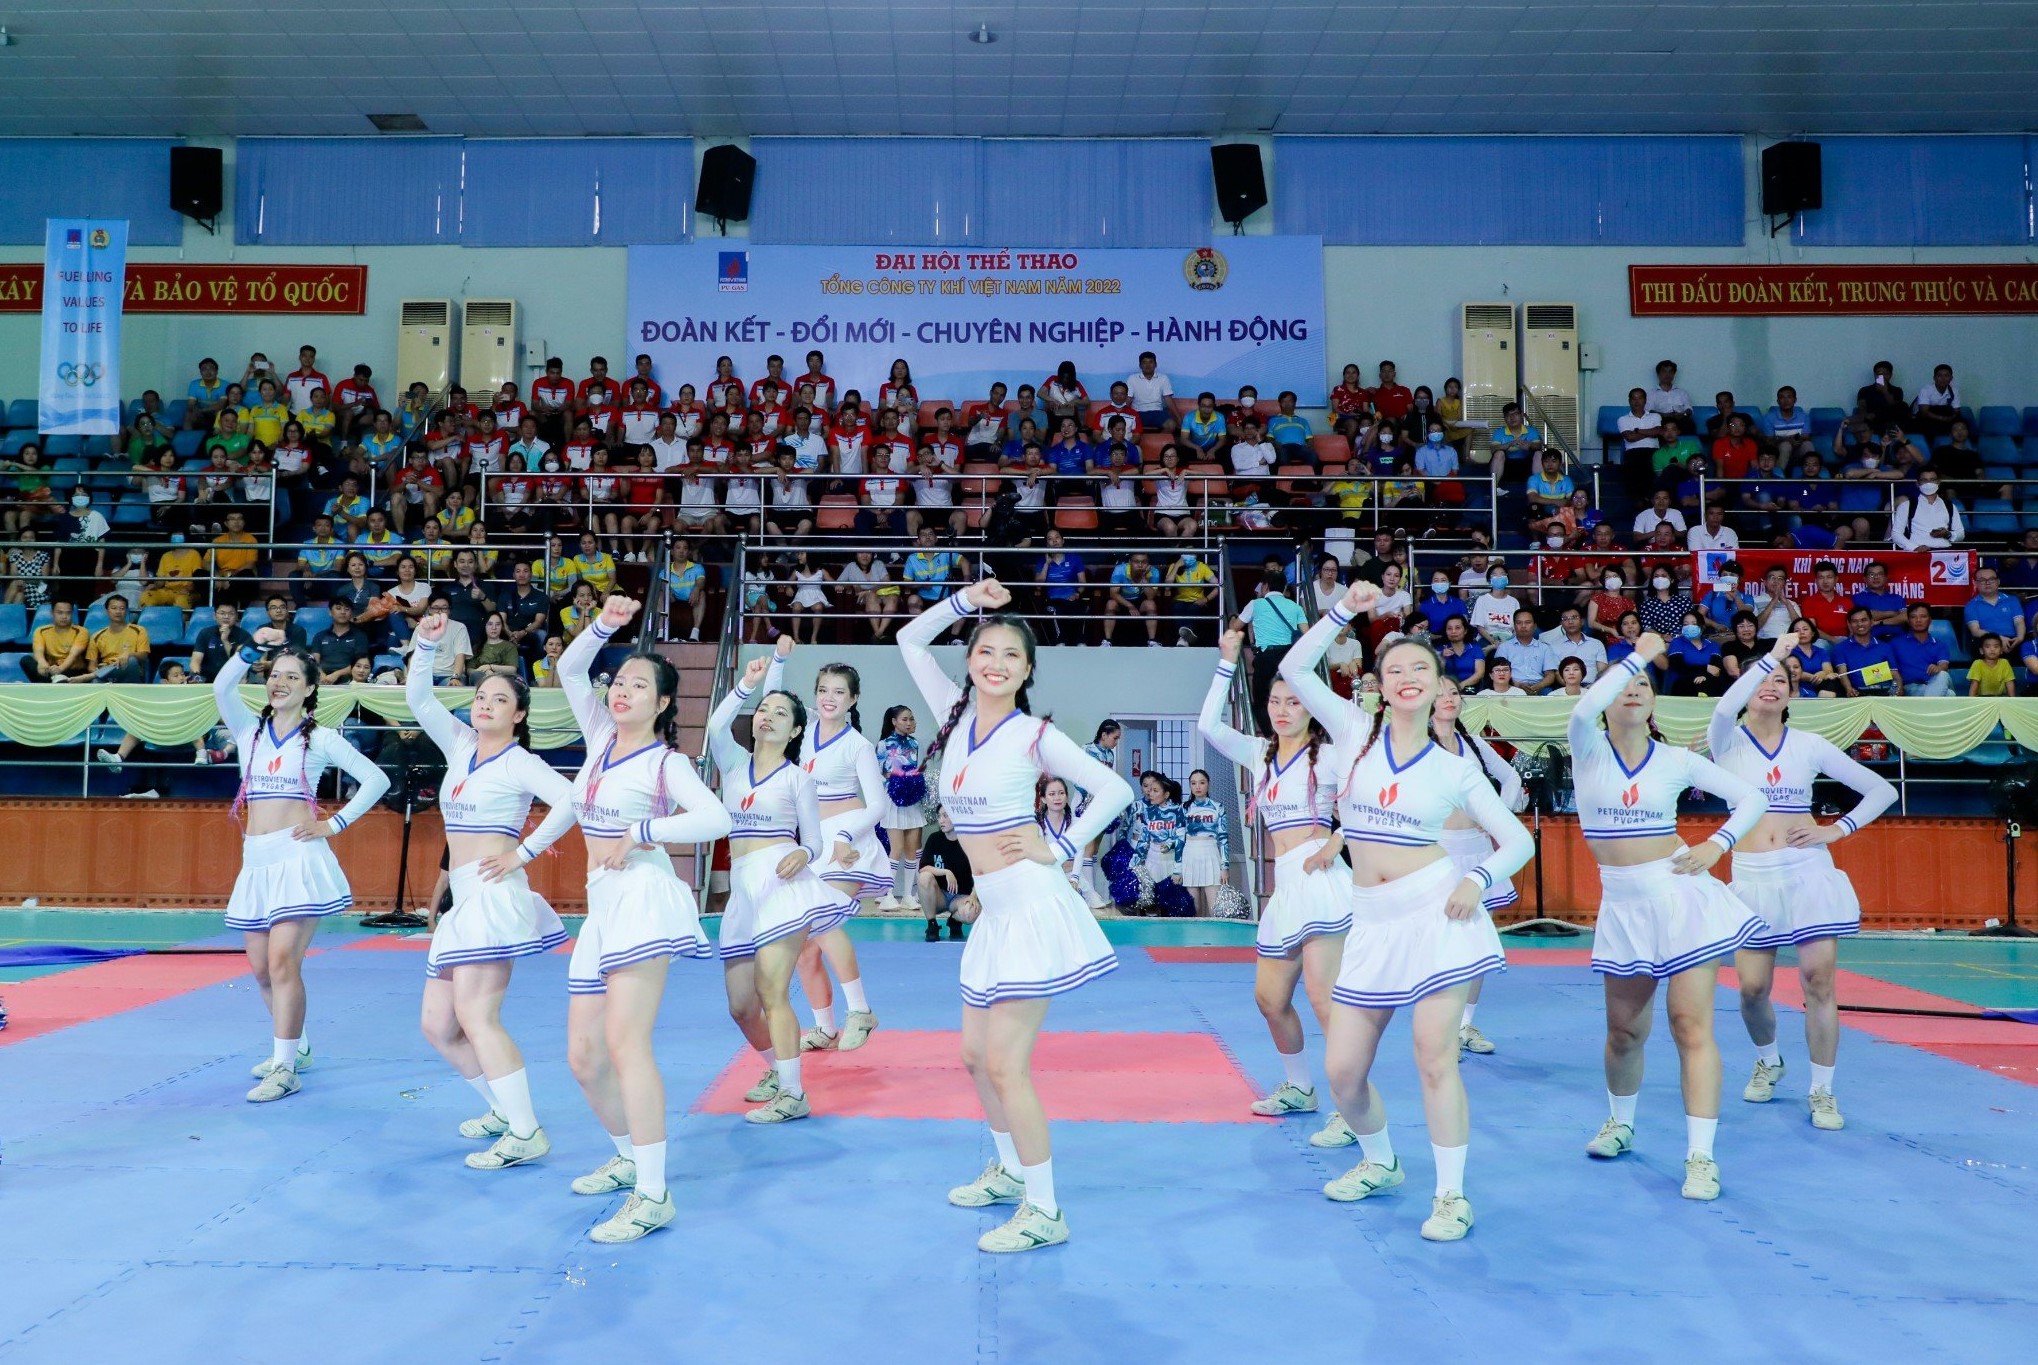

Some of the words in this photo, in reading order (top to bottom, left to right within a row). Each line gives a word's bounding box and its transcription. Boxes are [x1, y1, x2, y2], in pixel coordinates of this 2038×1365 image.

[875, 254, 915, 273] ĐẠI
[921, 250, 961, 274] HỘI
[966, 246, 1011, 270] THỂ
[1017, 253, 1078, 270] THAO
[57, 271, 112, 283] FUELLING
[820, 273, 863, 294] TỔNG
[867, 277, 914, 294] CÔNG
[918, 280, 935, 294] TY
[940, 276, 965, 294] KHÍ
[969, 277, 1001, 297] VIỆT
[1005, 279, 1041, 294] NAM
[1045, 277, 1082, 294] NĂM
[1085, 279, 1121, 294] 2022
[153, 272, 201, 301] BẢO
[208, 276, 238, 306] VỆ
[246, 272, 277, 302] TỔ
[283, 272, 349, 306] QUỐC
[1641, 282, 1676, 303] THI
[1681, 272, 1722, 303] ĐẤU
[1728, 275, 1783, 303] ĐOÀN
[1788, 272, 1834, 307] KẾT,
[1838, 281, 1905, 302] TRUNG
[1911, 276, 1966, 307] THỰC
[1971, 275, 1998, 302] VÀ
[62, 296, 105, 308] VALUES
[63, 322, 78, 333] TO
[81, 322, 102, 333] LIFE
[641, 317, 717, 343] ĐOÀN
[725, 315, 771, 342] KẾT
[790, 314, 837, 343] ĐỔI
[846, 317, 895, 343] MỚI
[917, 317, 1021, 343] CHUYÊN
[1029, 317, 1124, 348] NGHIỆP
[1147, 316, 1222, 342] HÀNH
[1228, 315, 1308, 347] ĐỘNG
[1793, 554, 1812, 573] KHÍ
[1353, 804, 1421, 826] PETROVIETNAM
[1368, 815, 1402, 829] PVGAS
[1598, 808, 1663, 819] PETROVIETNAM
